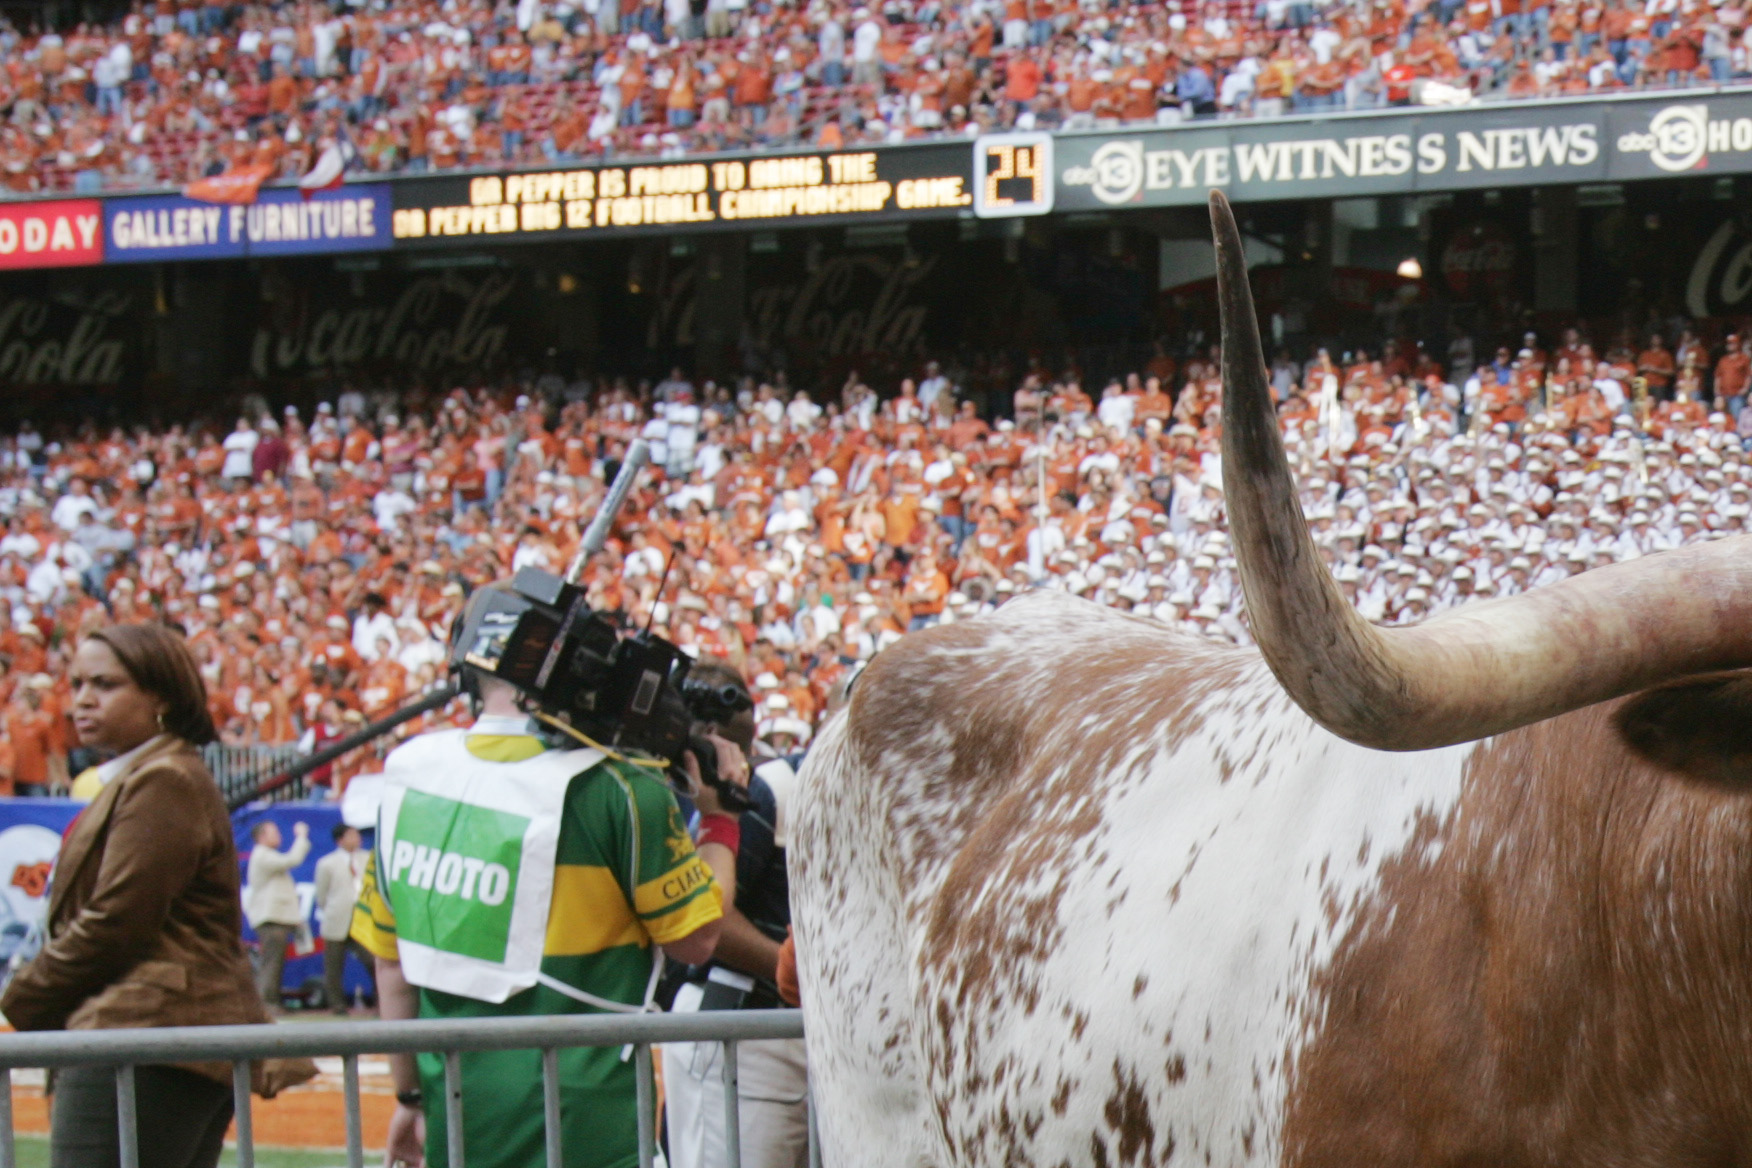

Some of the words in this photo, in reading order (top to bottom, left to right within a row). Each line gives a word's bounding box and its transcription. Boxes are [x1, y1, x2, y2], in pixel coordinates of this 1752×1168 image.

[1456, 122, 1599, 172] NEWS
[505, 169, 596, 204] PEPPER
[598, 168, 626, 199] IS
[629, 163, 709, 197] PROUD
[712, 160, 745, 191] TO
[827, 152, 878, 184] THE
[985, 143, 1044, 208] 24
[112, 206, 222, 249] GALLERY
[228, 198, 376, 240] FURNITURE
[428, 203, 518, 236] PEPPER
[565, 199, 592, 229] 12
[595, 192, 716, 228] FOOTBALL
[719, 181, 892, 219] CHAMPIONSHIP
[896, 176, 973, 210] GAME.
[391, 840, 510, 907] PHOTO
